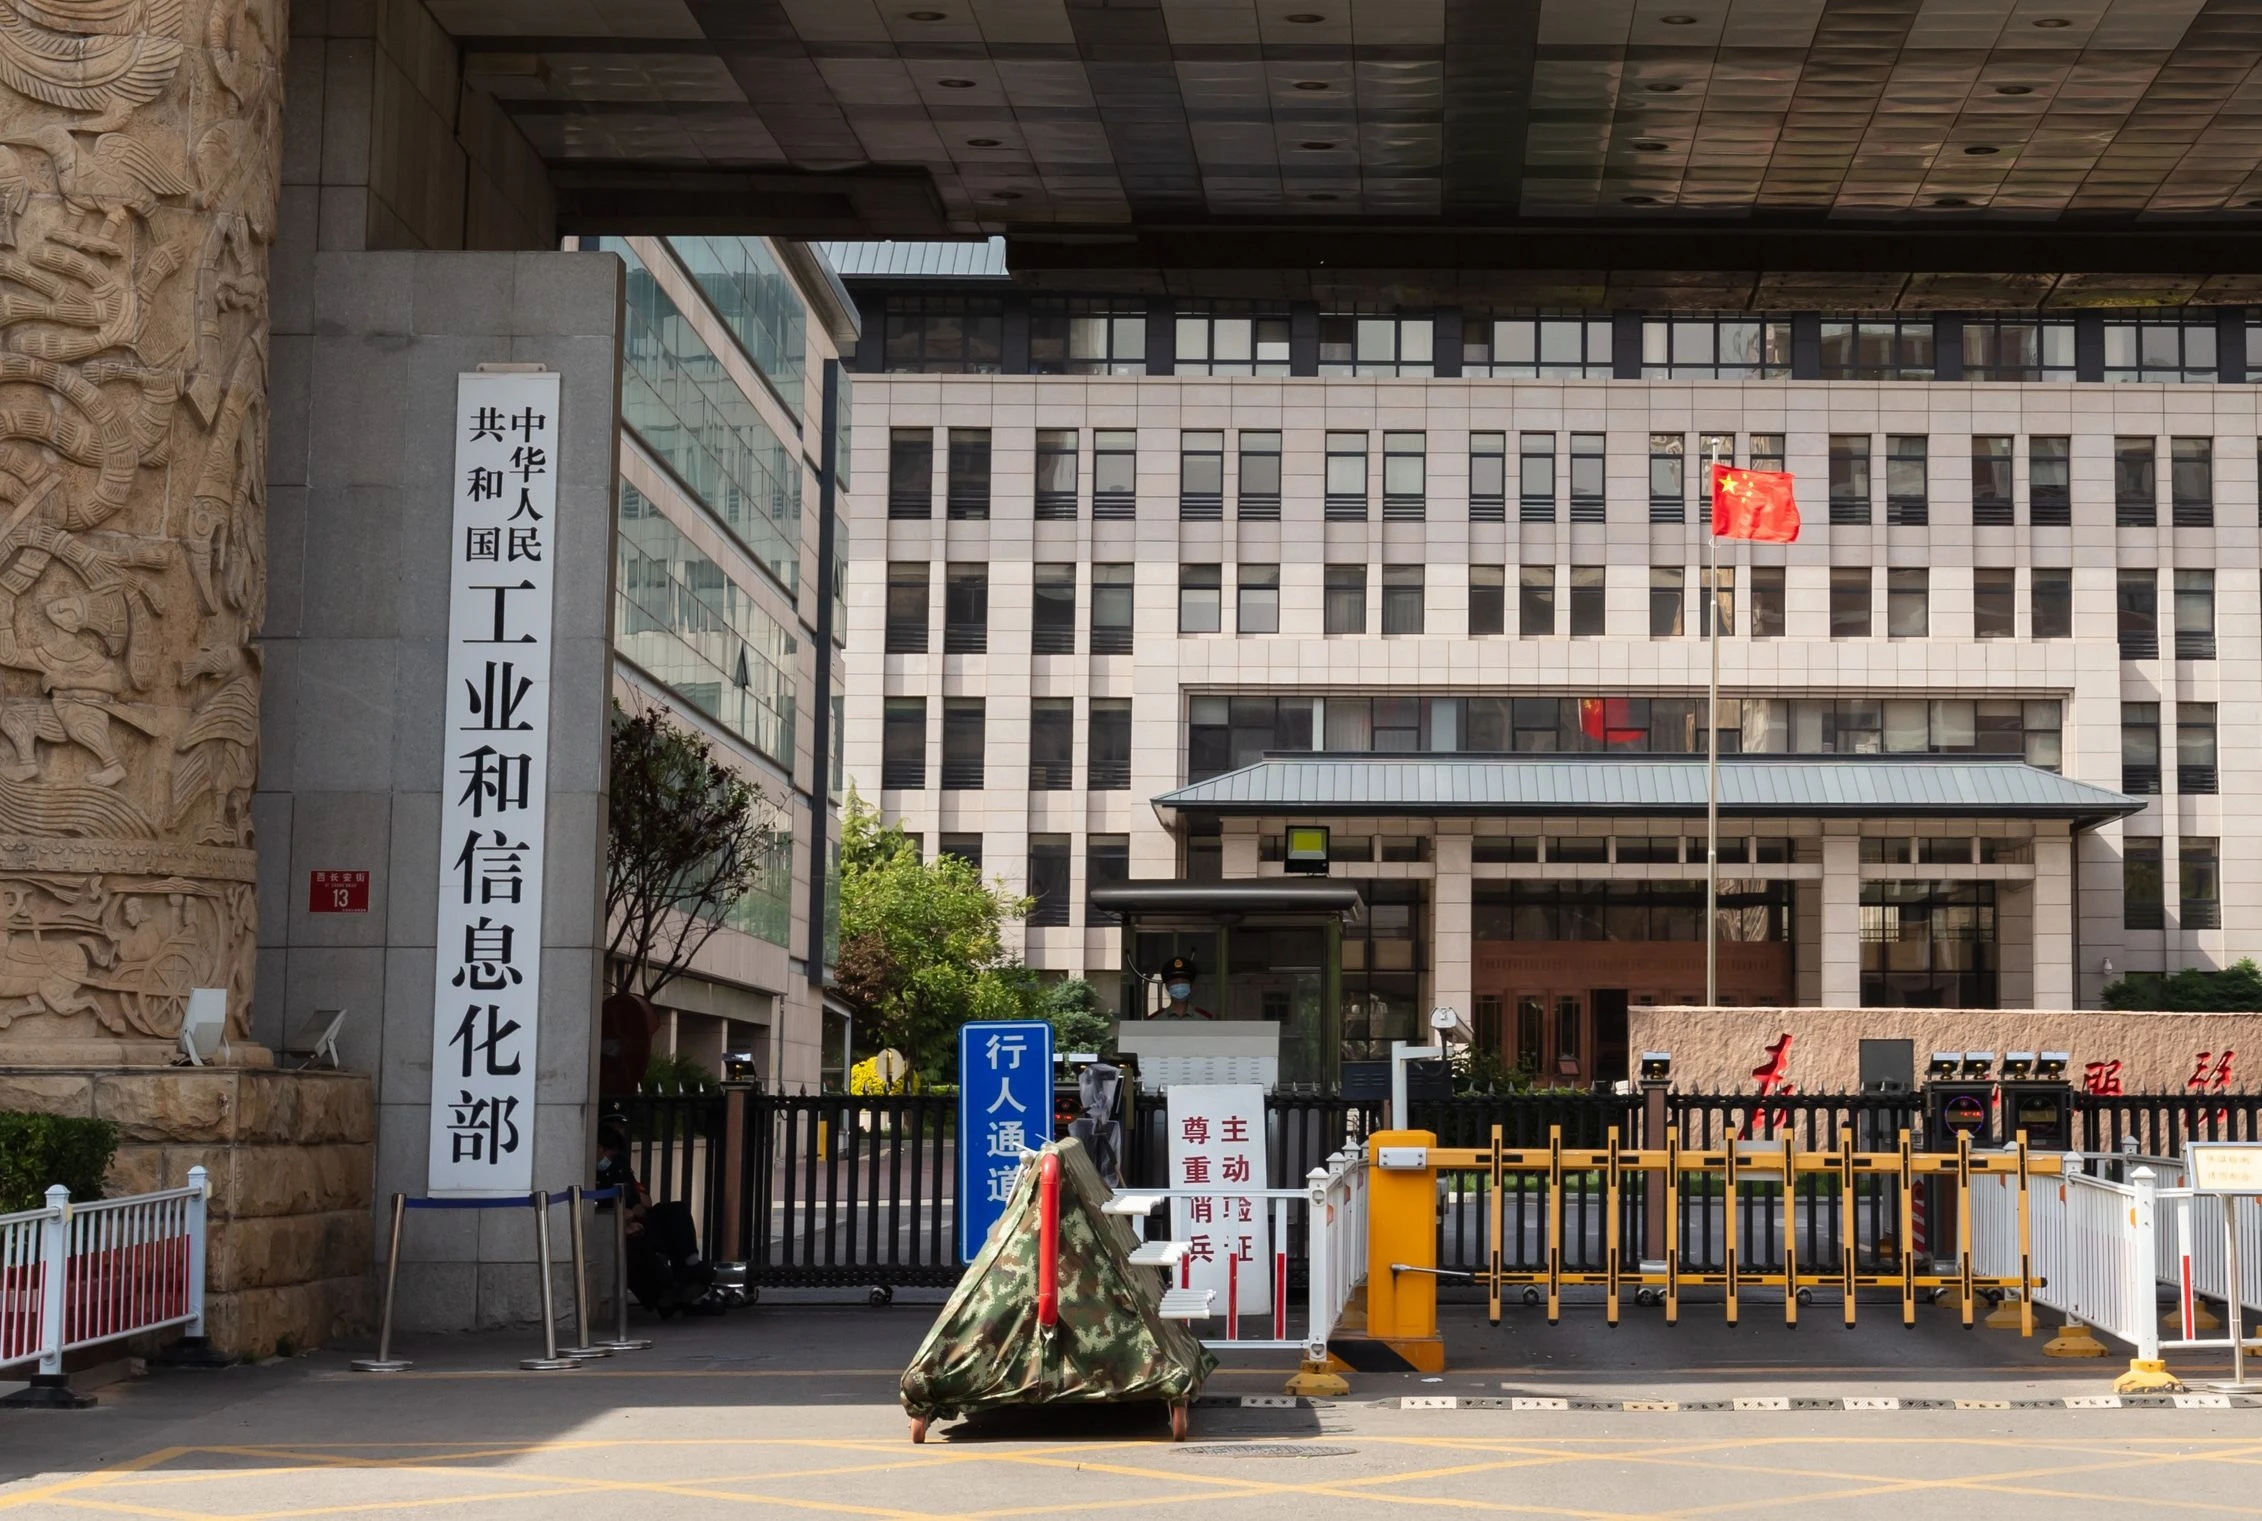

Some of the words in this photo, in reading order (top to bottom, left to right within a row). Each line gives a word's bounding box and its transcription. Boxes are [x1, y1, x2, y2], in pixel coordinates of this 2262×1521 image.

[466, 406, 506, 562] 共和国
[507, 406, 546, 562] 中华人民
[332, 888, 349, 907] 13
[446, 579, 537, 1165] 工业和信息化部
[985, 1034, 1027, 1202] 行人通道
